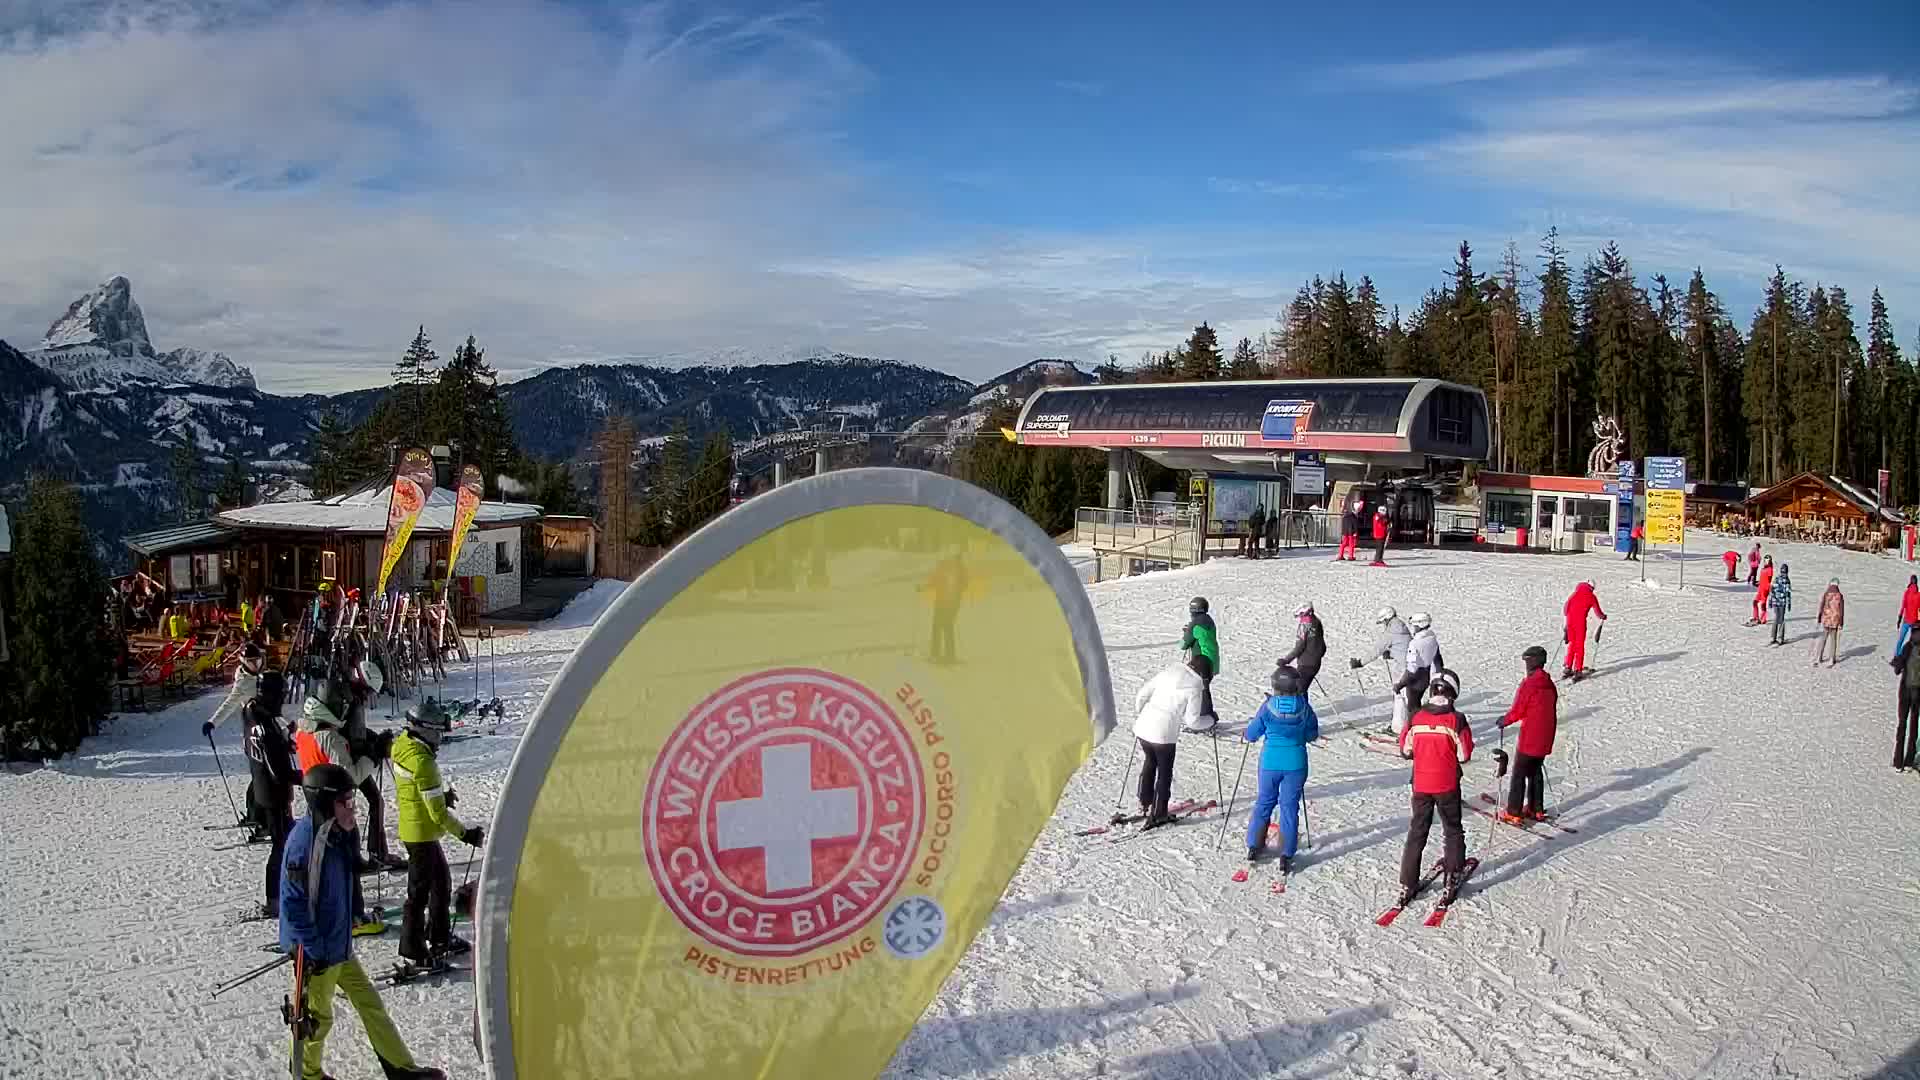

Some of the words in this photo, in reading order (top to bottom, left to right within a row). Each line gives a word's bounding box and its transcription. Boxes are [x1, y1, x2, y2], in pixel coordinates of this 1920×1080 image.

[1026, 422, 1059, 430] SUPERSKI
[1037, 414, 1069, 422] DOLOMITI
[1202, 433, 1246, 448] PICULIN
[896, 682, 945, 748] PISTE
[663, 689, 798, 819] WEISSES
[808, 692, 905, 796] KREUZ
[916, 751, 954, 887] SOCCORSO
[670, 846, 778, 939] CROCE
[791, 821, 905, 938] BIANCA
[684, 935, 877, 986] PISTENRETTUNG
